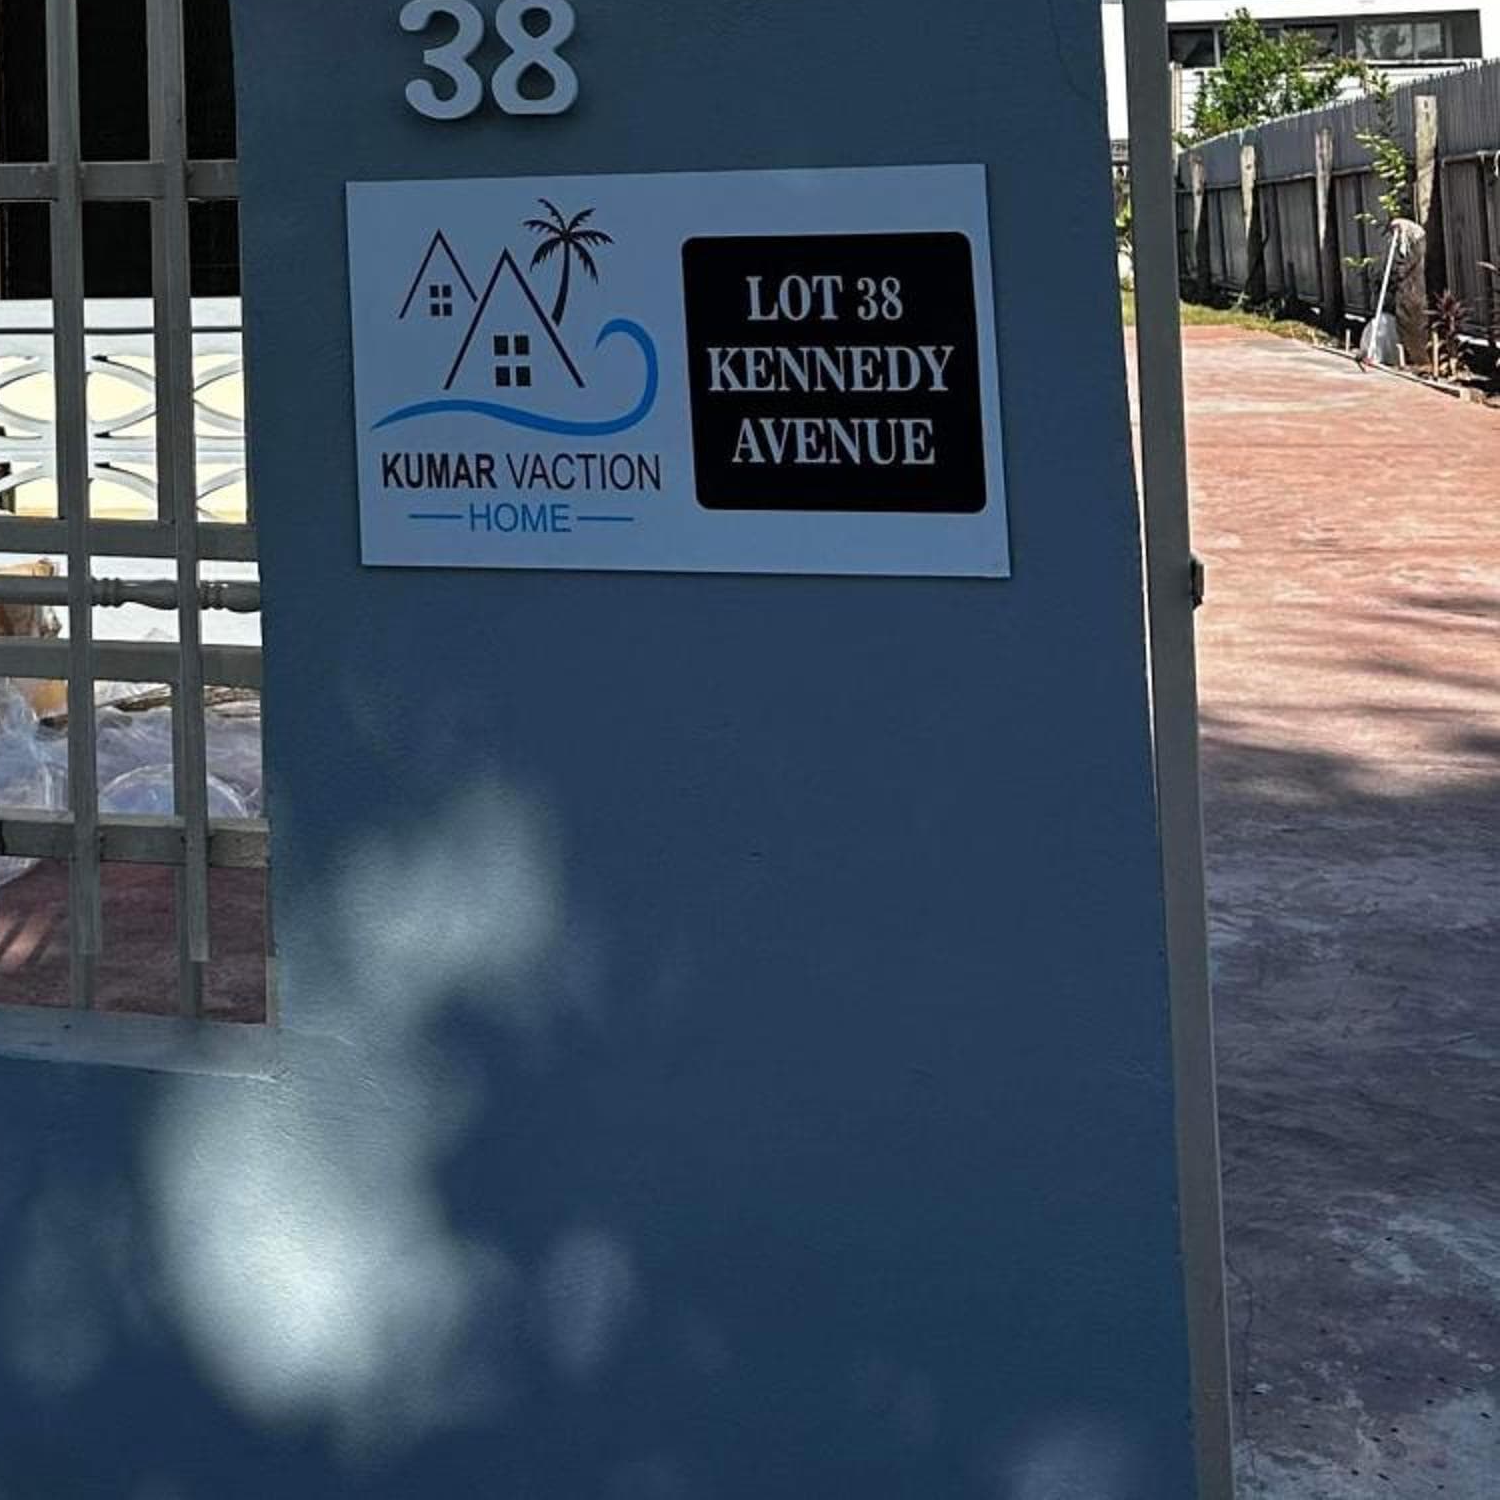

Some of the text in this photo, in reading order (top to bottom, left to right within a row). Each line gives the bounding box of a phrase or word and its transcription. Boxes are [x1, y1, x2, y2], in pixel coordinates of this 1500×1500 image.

[745, 274, 904, 322] LOT 38
[706, 345, 955, 393] KENNEDY
[731, 417, 937, 466] AVENUE
[381, 452, 662, 491] KUMAR VACTION
[469, 502, 573, 534] HOME
